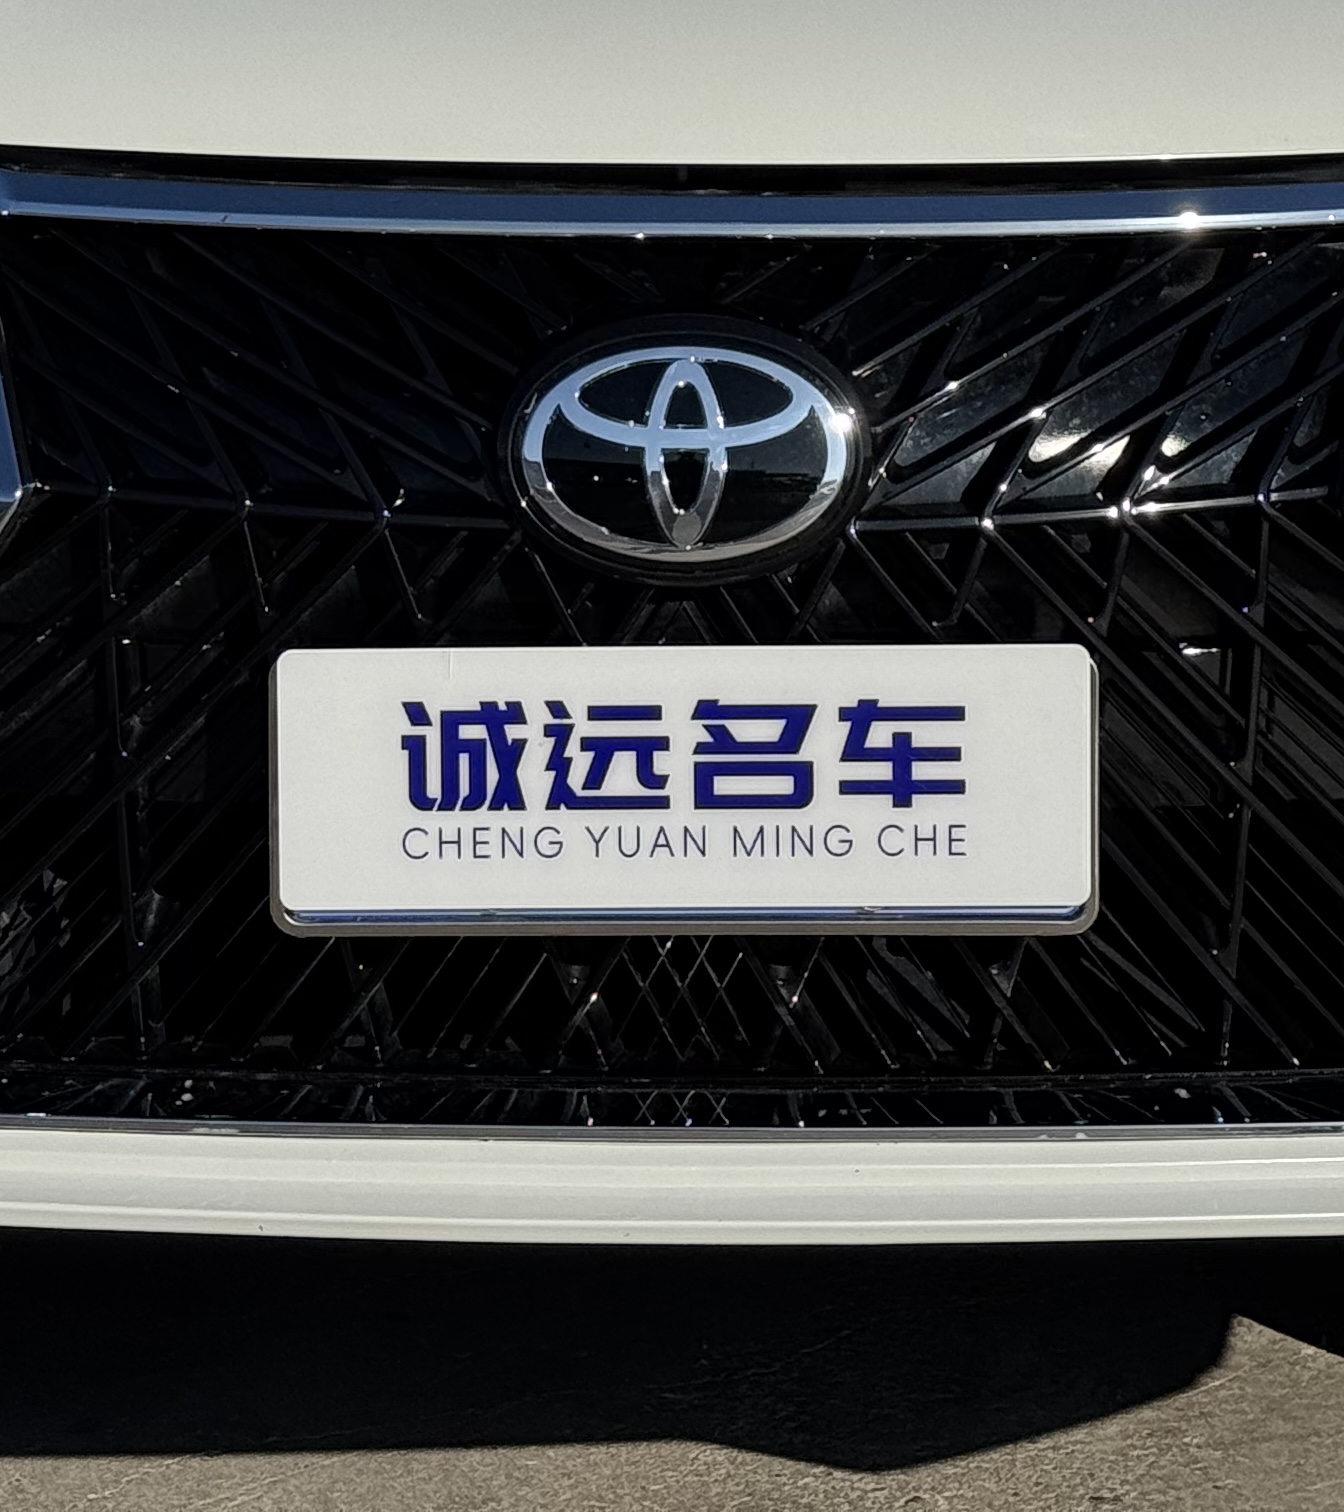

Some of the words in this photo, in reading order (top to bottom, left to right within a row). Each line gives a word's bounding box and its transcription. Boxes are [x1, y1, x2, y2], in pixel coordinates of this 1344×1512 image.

[400, 698, 968, 812] 诚远名车
[401, 825, 565, 861] CHENG
[583, 824, 709, 859] YUAN
[731, 824, 856, 859] MING
[876, 823, 968, 858] CHE
